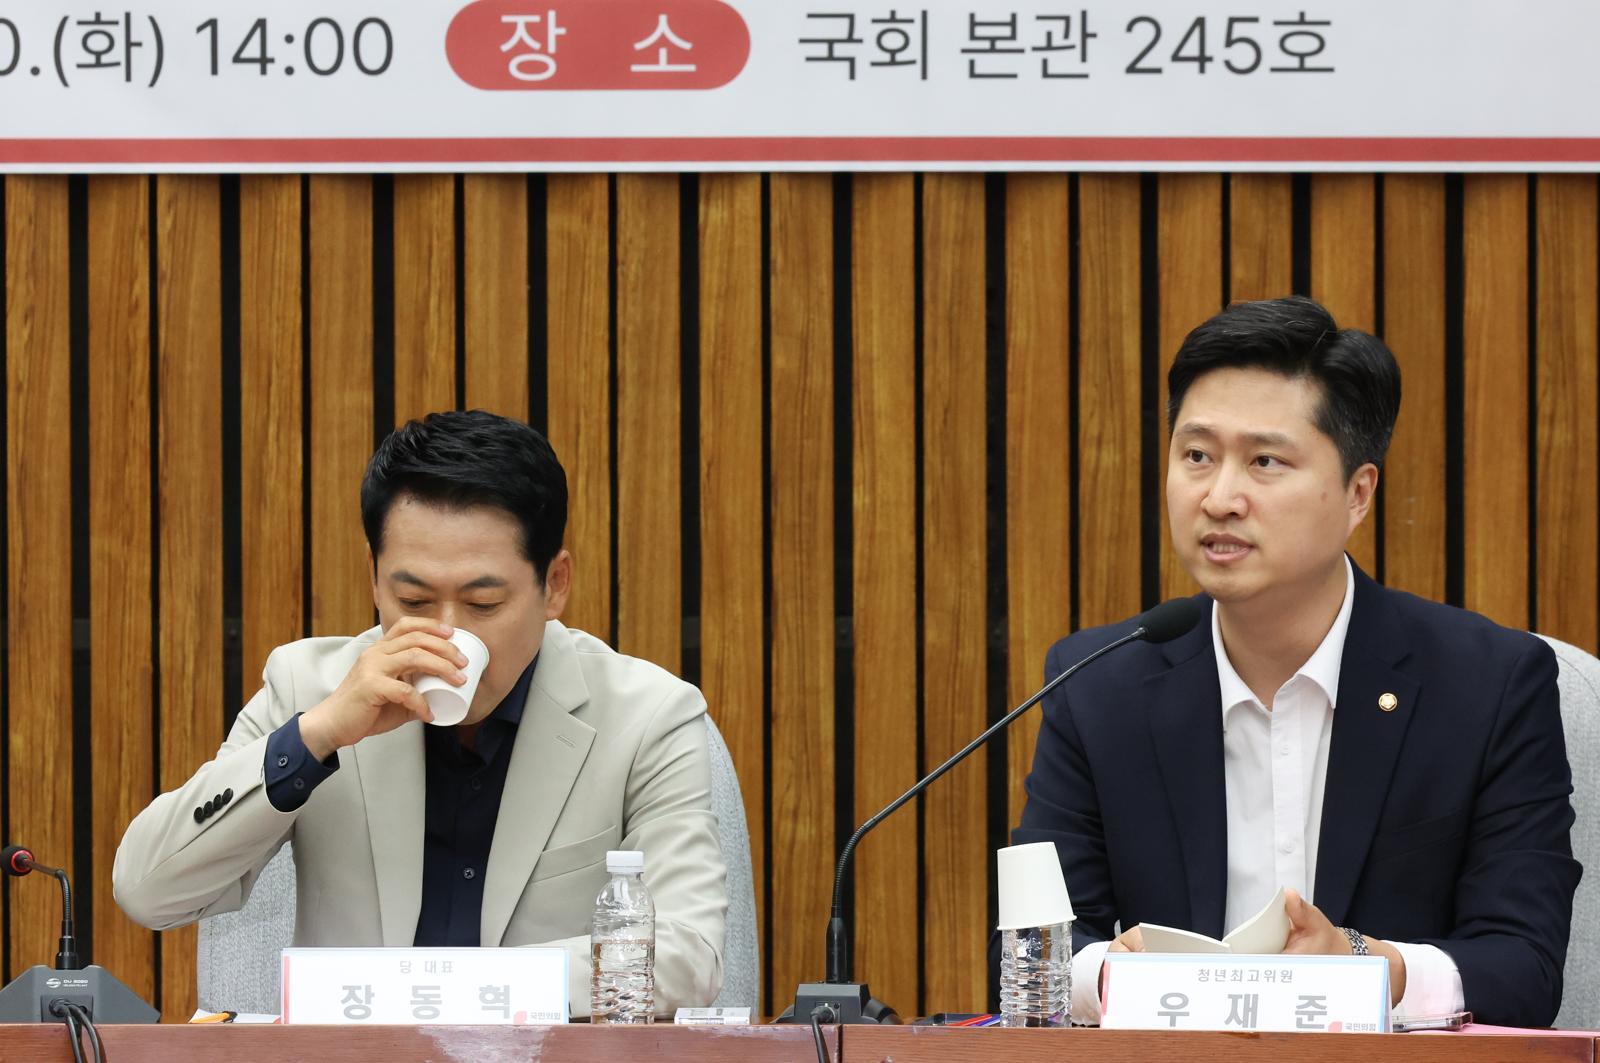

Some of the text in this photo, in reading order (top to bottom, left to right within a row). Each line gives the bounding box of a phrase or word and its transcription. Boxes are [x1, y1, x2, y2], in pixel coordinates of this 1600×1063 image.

[195, 17, 394, 77] 14:00
[798, 9, 1336, 81] 국회 본관 245호
[1197, 968, 1293, 984] 청년최고위원
